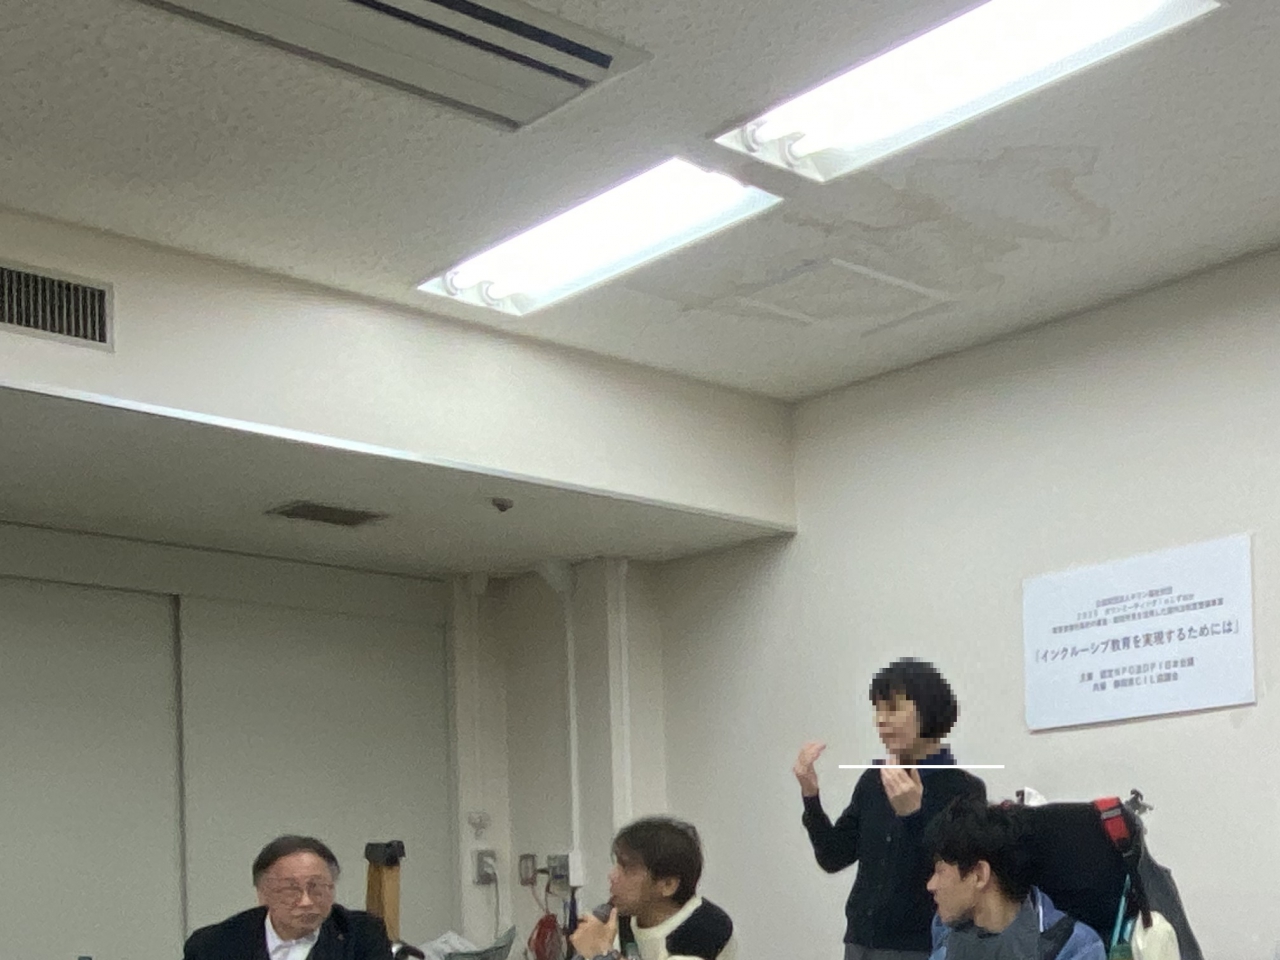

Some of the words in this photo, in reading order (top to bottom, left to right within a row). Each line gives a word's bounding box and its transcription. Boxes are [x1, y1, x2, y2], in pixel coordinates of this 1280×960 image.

[1035, 619, 1240, 664] 「インクルーシブ教育を実現するためには」
